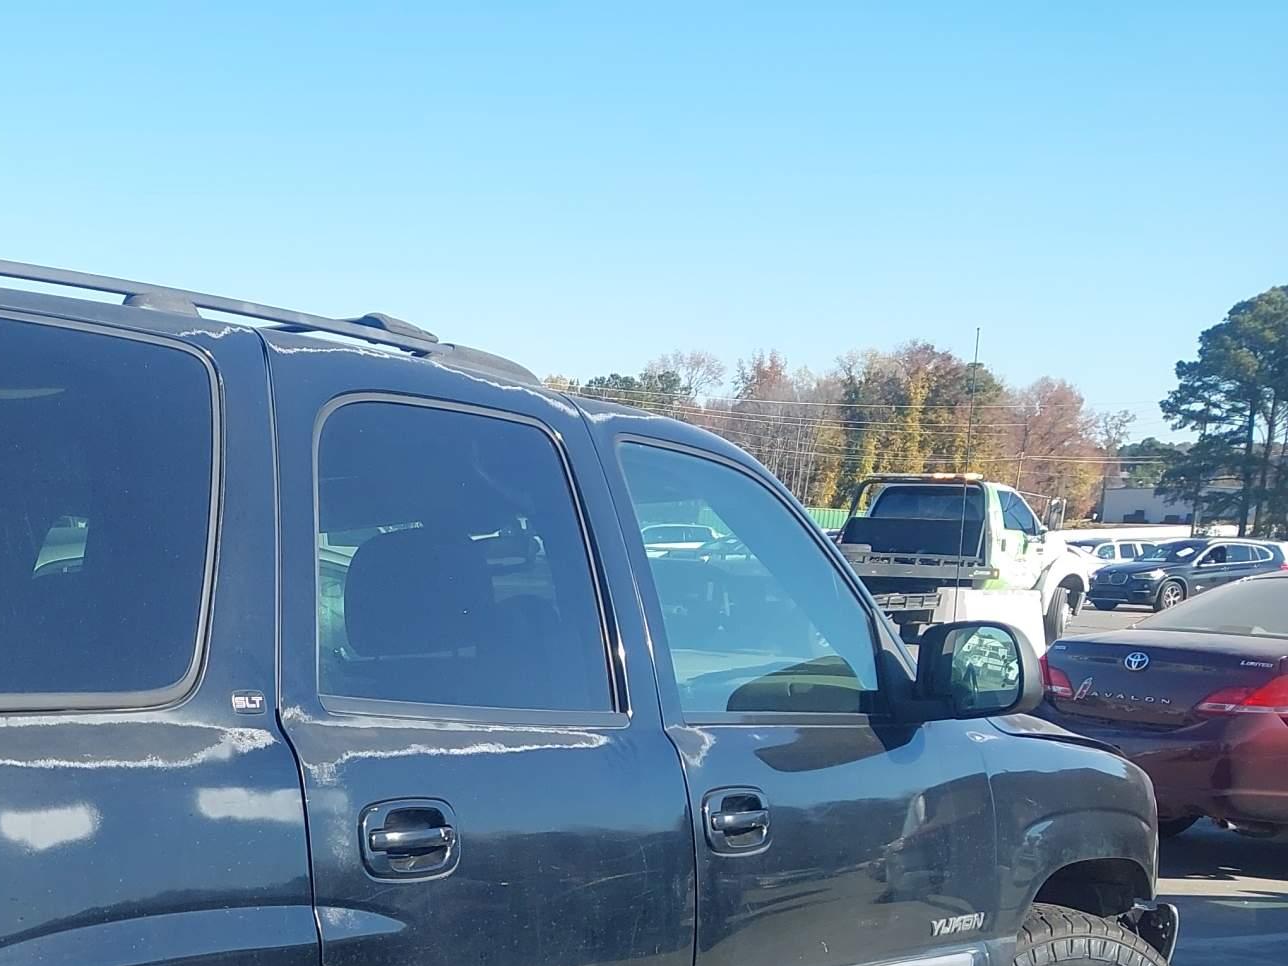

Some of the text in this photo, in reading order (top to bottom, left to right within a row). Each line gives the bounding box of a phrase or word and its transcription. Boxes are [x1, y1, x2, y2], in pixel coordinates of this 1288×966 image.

[234, 696, 263, 709] SLT
[1090, 691, 1171, 704] AVALON
[931, 911, 985, 937] YUKON
